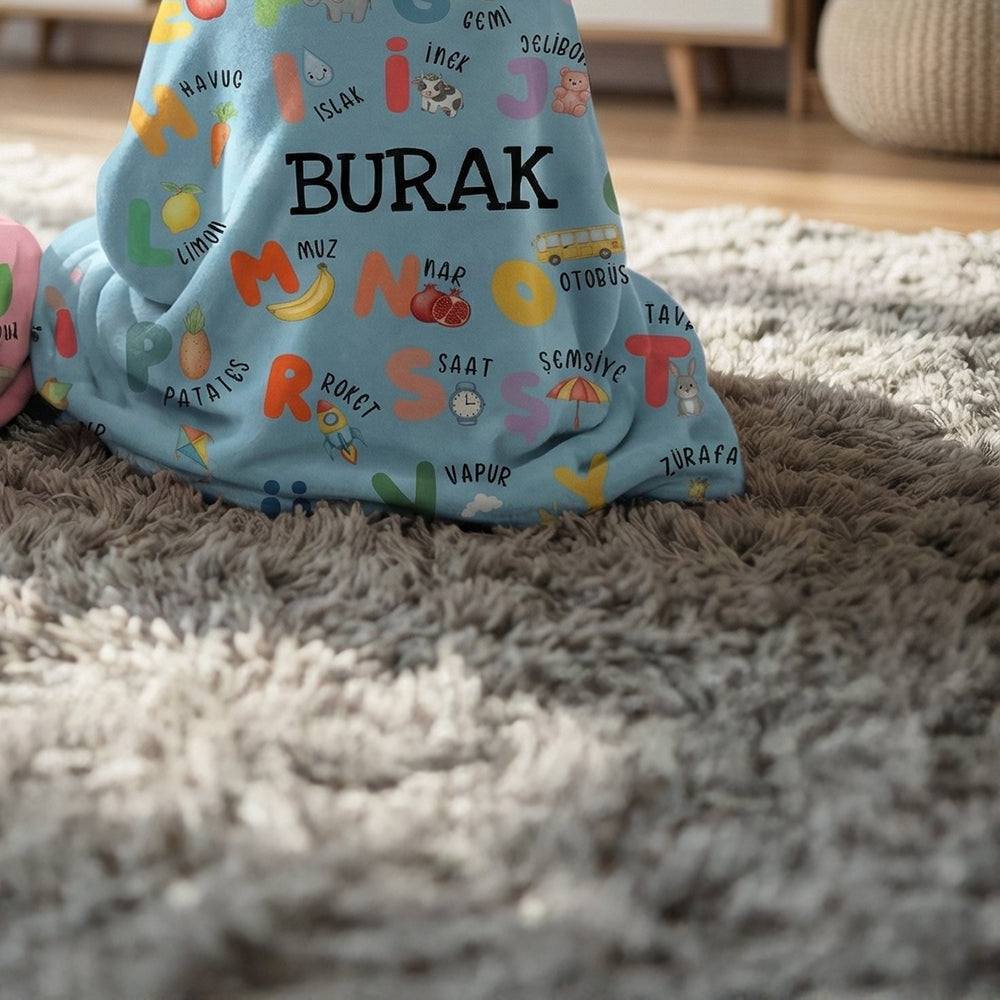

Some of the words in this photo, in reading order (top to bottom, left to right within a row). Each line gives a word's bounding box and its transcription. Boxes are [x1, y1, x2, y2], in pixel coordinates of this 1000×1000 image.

[314, 86, 364, 123] ISLAK
[496, 57, 549, 120] J
[286, 146, 559, 216] BURAK
[127, 198, 174, 267] L
[297, 239, 338, 260] MUZ
[230, 240, 300, 307] M
[354, 251, 420, 318] N
[424, 258, 467, 287] NAR
[491, 260, 557, 327] O
[559, 262, 630, 292] OTOBÜS
[126, 321, 172, 393] P
[163, 358, 250, 409] PATATES
[264, 354, 313, 422] R
[385, 347, 446, 421] S
[438, 353, 494, 377] SAAT
[625, 335, 691, 408] T
[321, 372, 381, 418] ROKET
[445, 463, 512, 487] VAPUR
